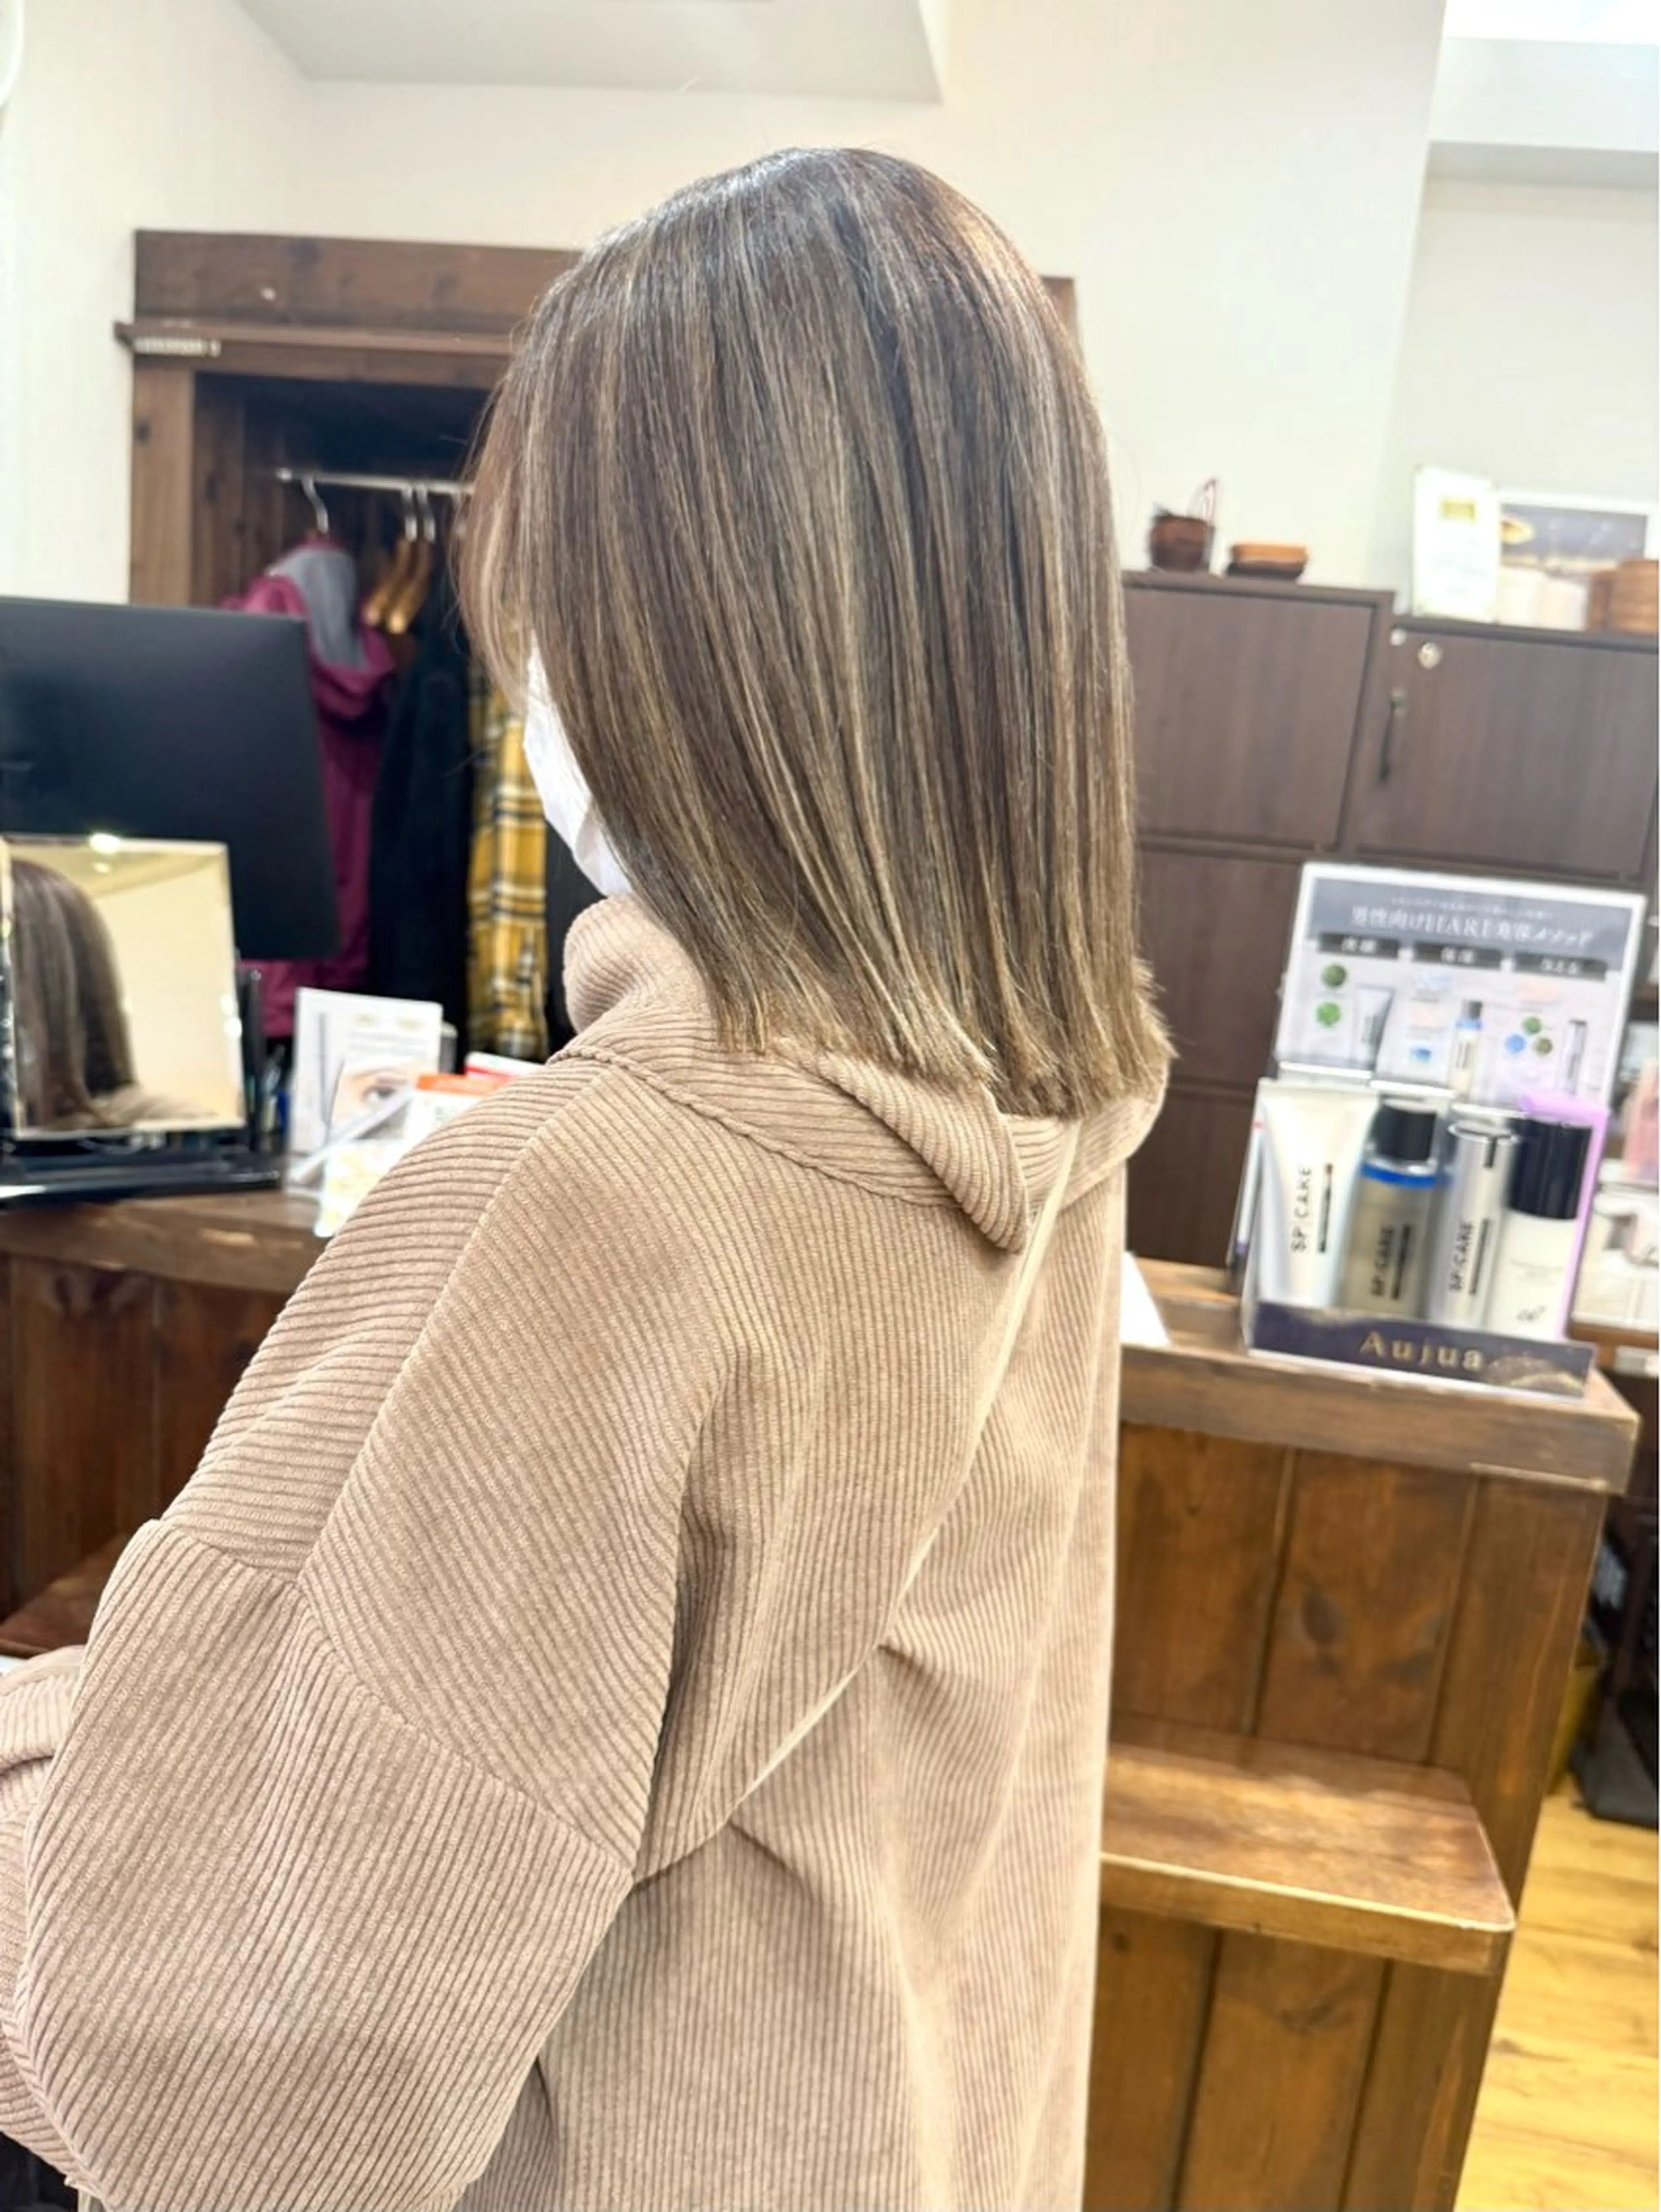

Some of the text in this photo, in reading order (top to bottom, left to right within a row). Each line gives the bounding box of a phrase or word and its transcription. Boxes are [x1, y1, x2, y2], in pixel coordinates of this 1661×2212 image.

[1289, 1167, 1312, 1253] SP CARE
[1360, 1330, 1484, 1371] Aujua
